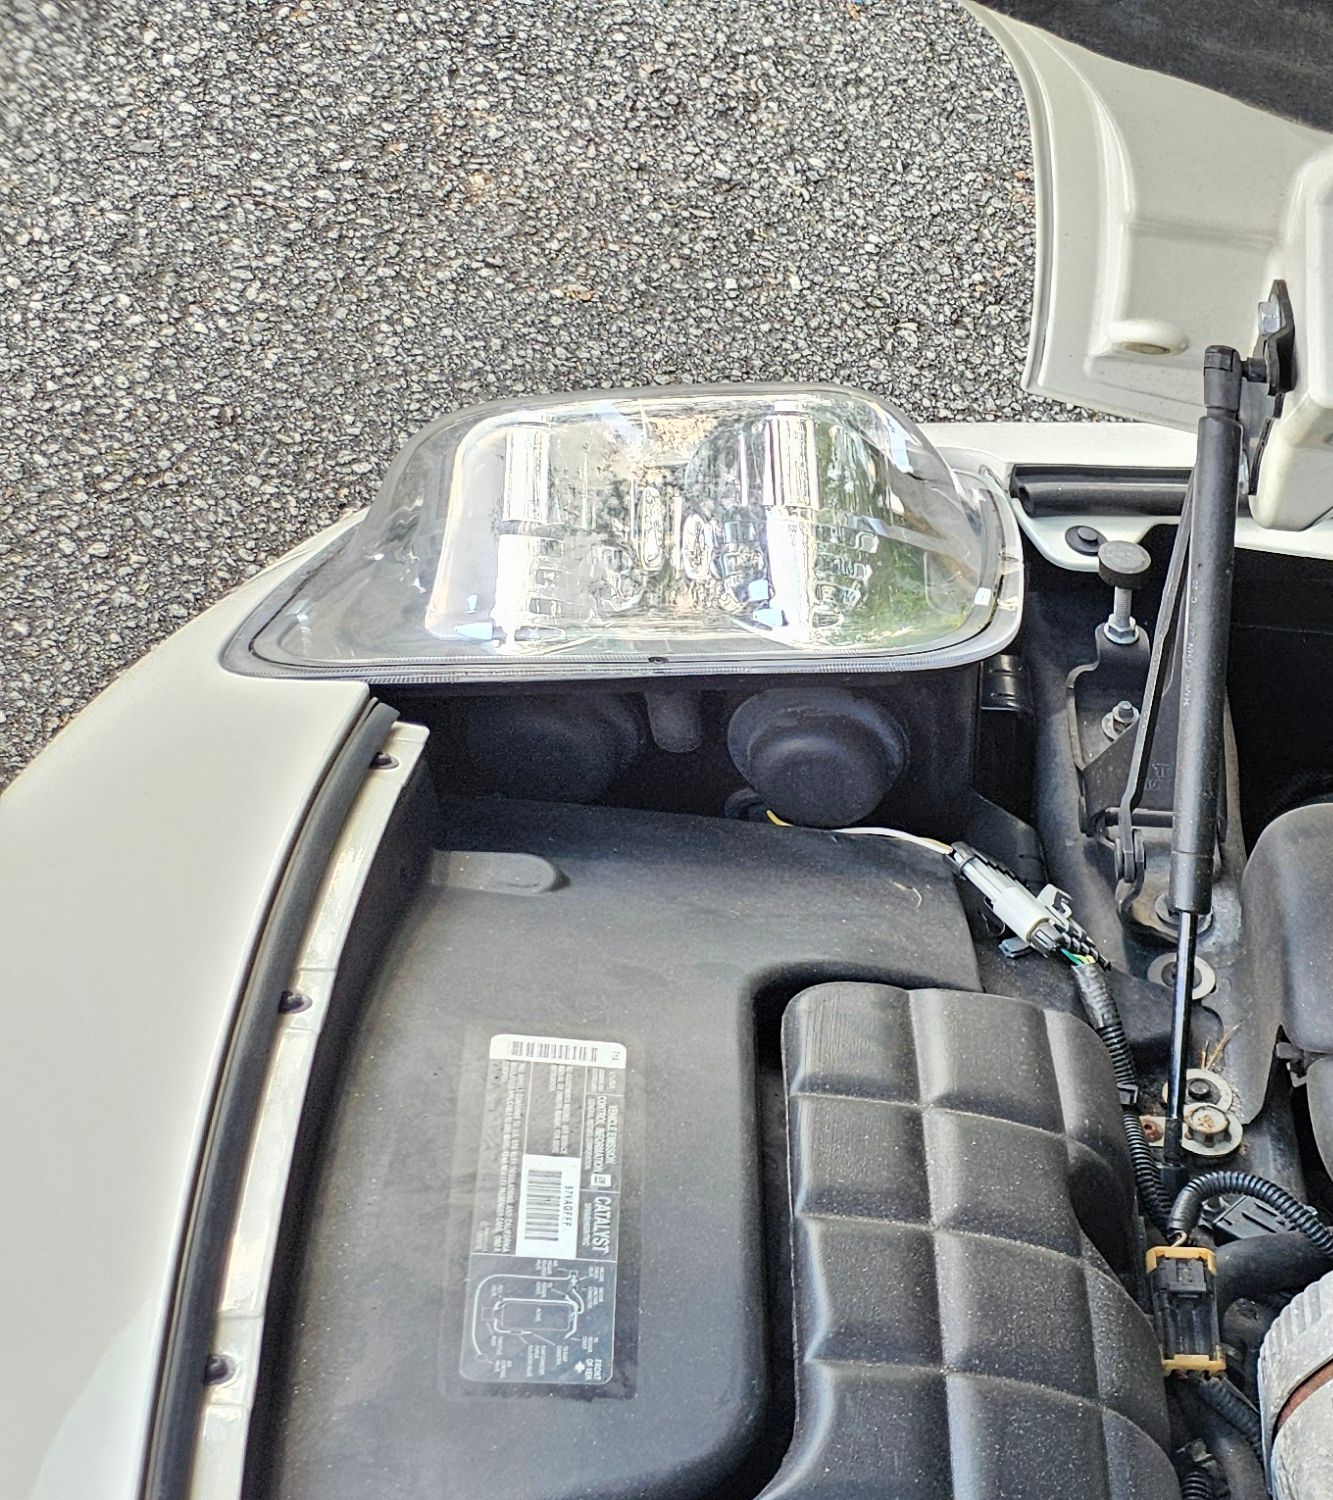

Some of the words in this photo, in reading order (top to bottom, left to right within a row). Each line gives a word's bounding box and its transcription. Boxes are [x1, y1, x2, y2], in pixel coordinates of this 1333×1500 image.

[595, 1095, 606, 1124] CONTROL
[607, 1105, 617, 1131] VEHICLE
[593, 1127, 604, 1172] INFORMATION
[605, 1132, 617, 1163] EMISSION
[591, 1196, 611, 1253] CATALYST
